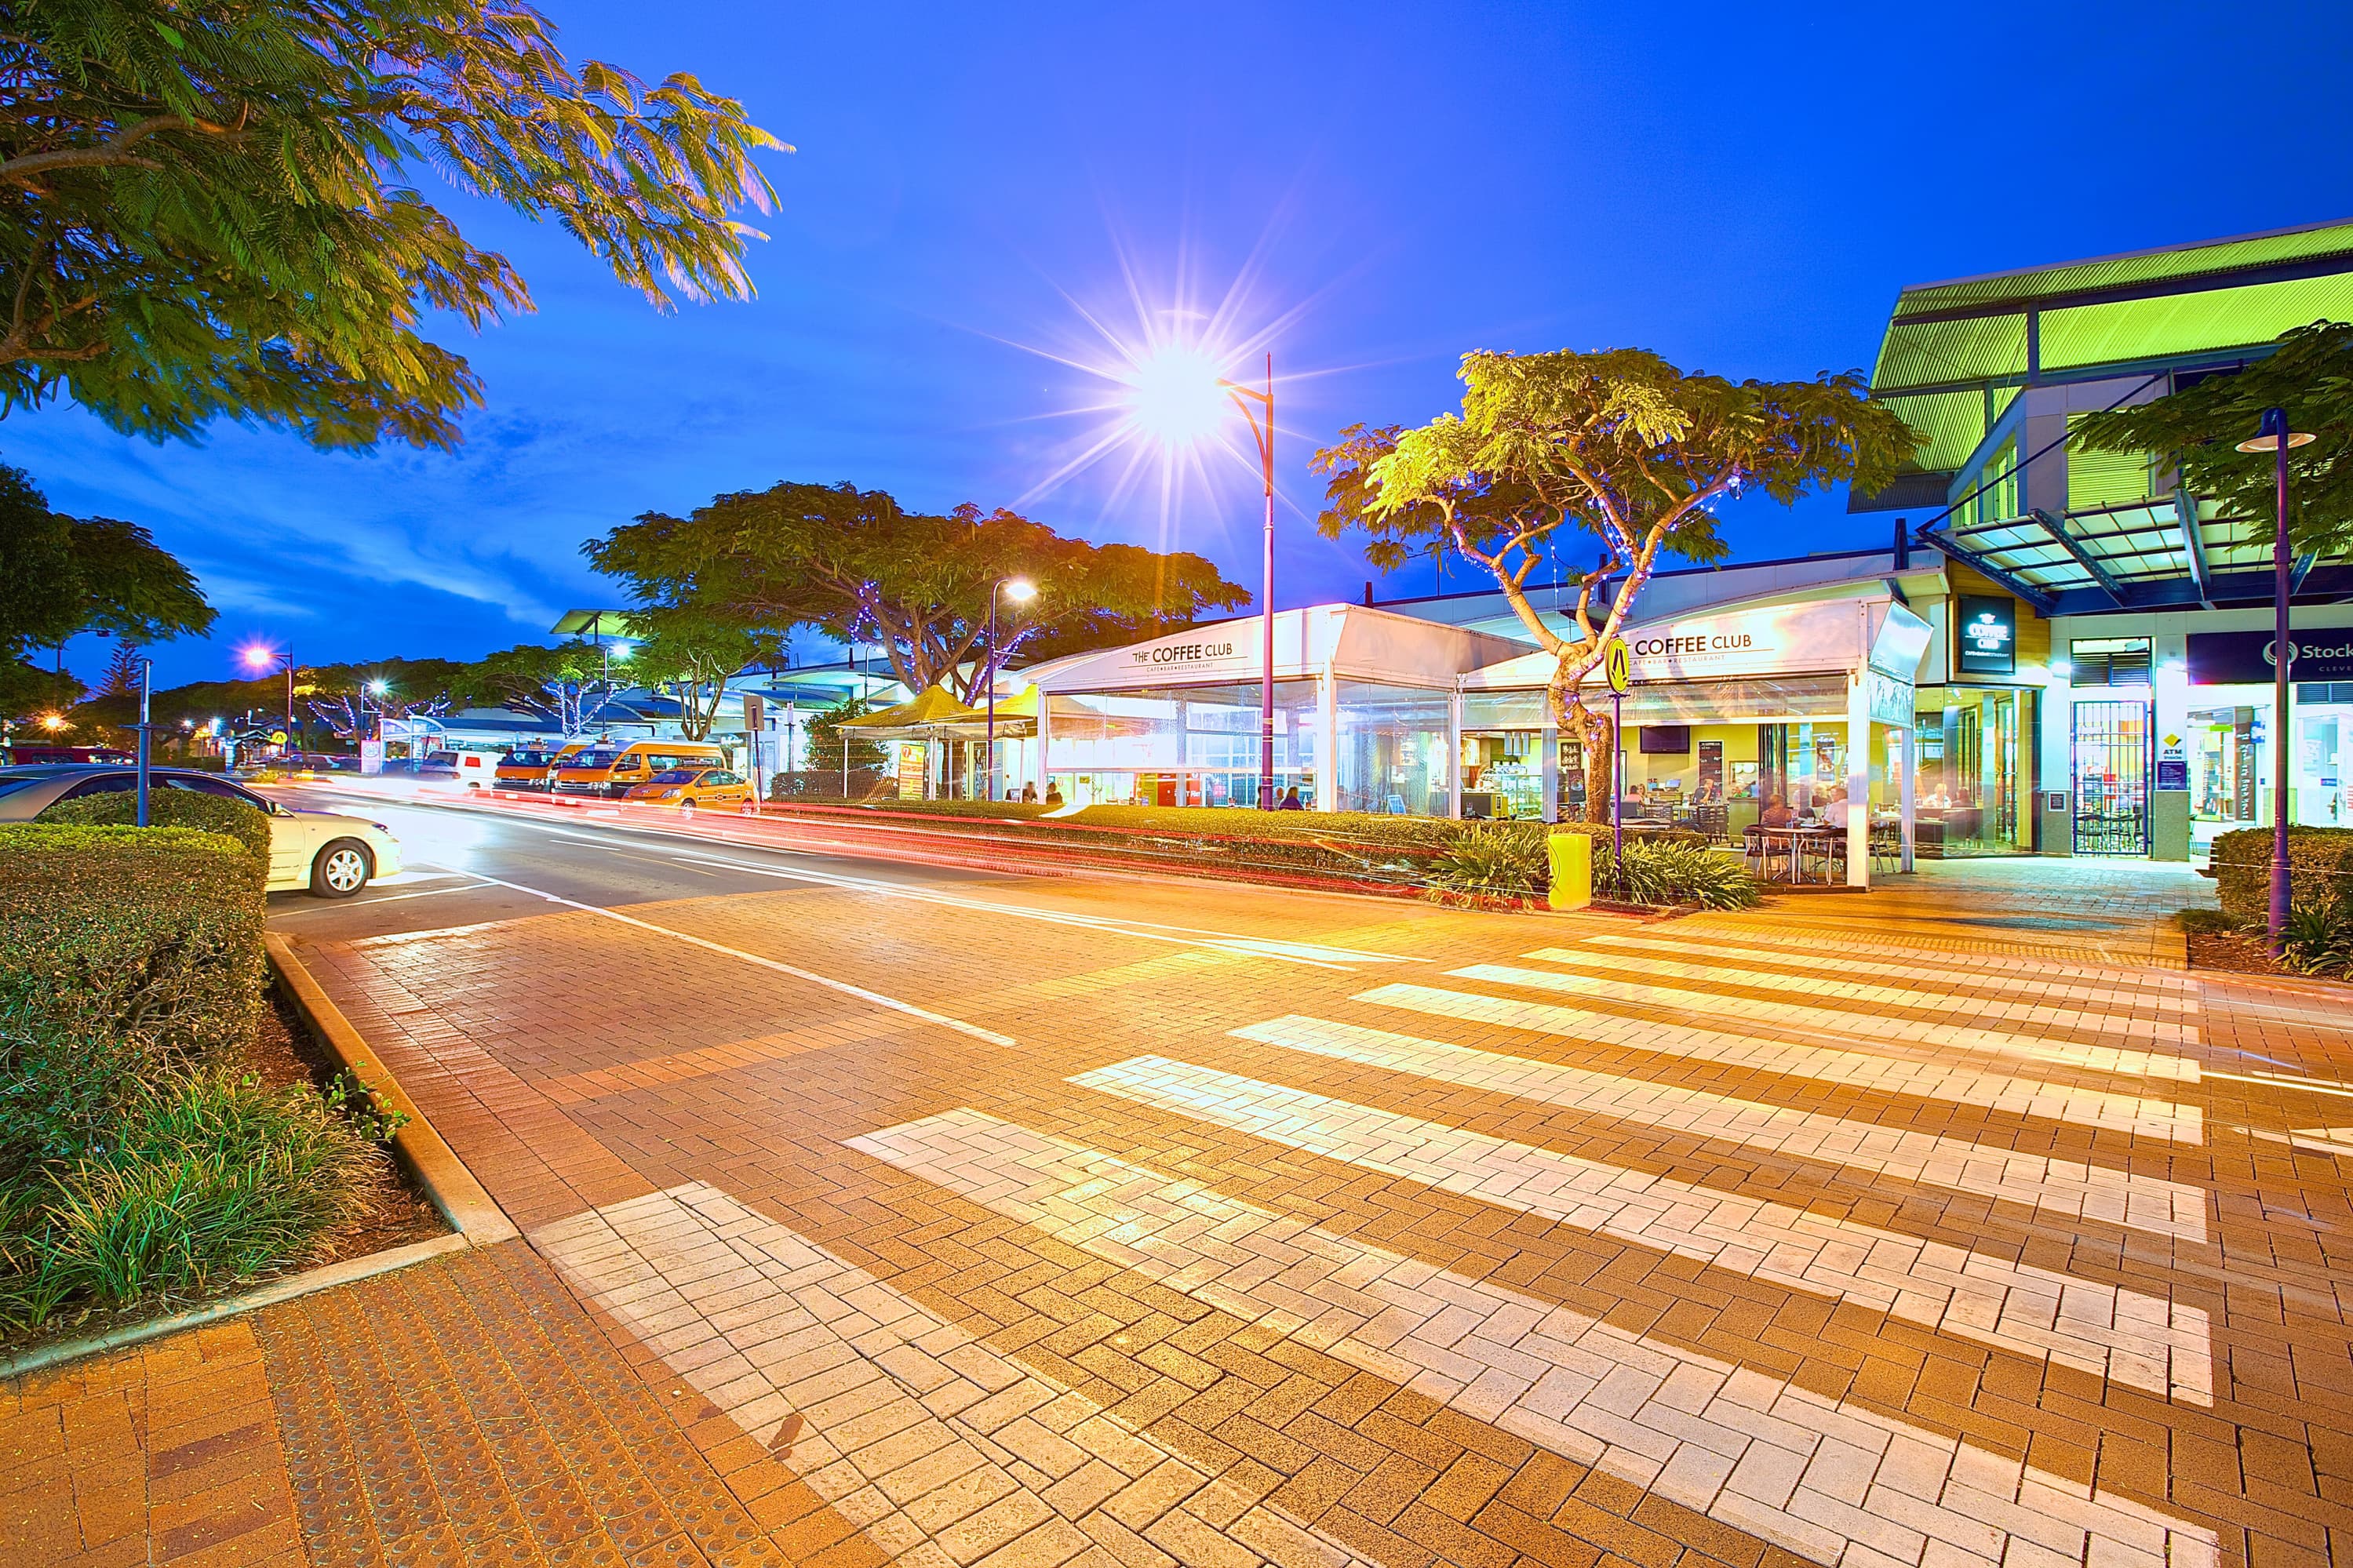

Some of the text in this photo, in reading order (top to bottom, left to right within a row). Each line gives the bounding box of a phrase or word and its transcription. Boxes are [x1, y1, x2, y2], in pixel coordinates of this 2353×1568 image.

[1132, 643, 1233, 663] THE COFFEE CLUB
[1635, 635, 1751, 656] COFFEE CLUB
[2302, 643, 2353, 658] Stock
[1178, 662, 1213, 671] RESTAURANT
[1674, 655, 1725, 664] RESTAURANT
